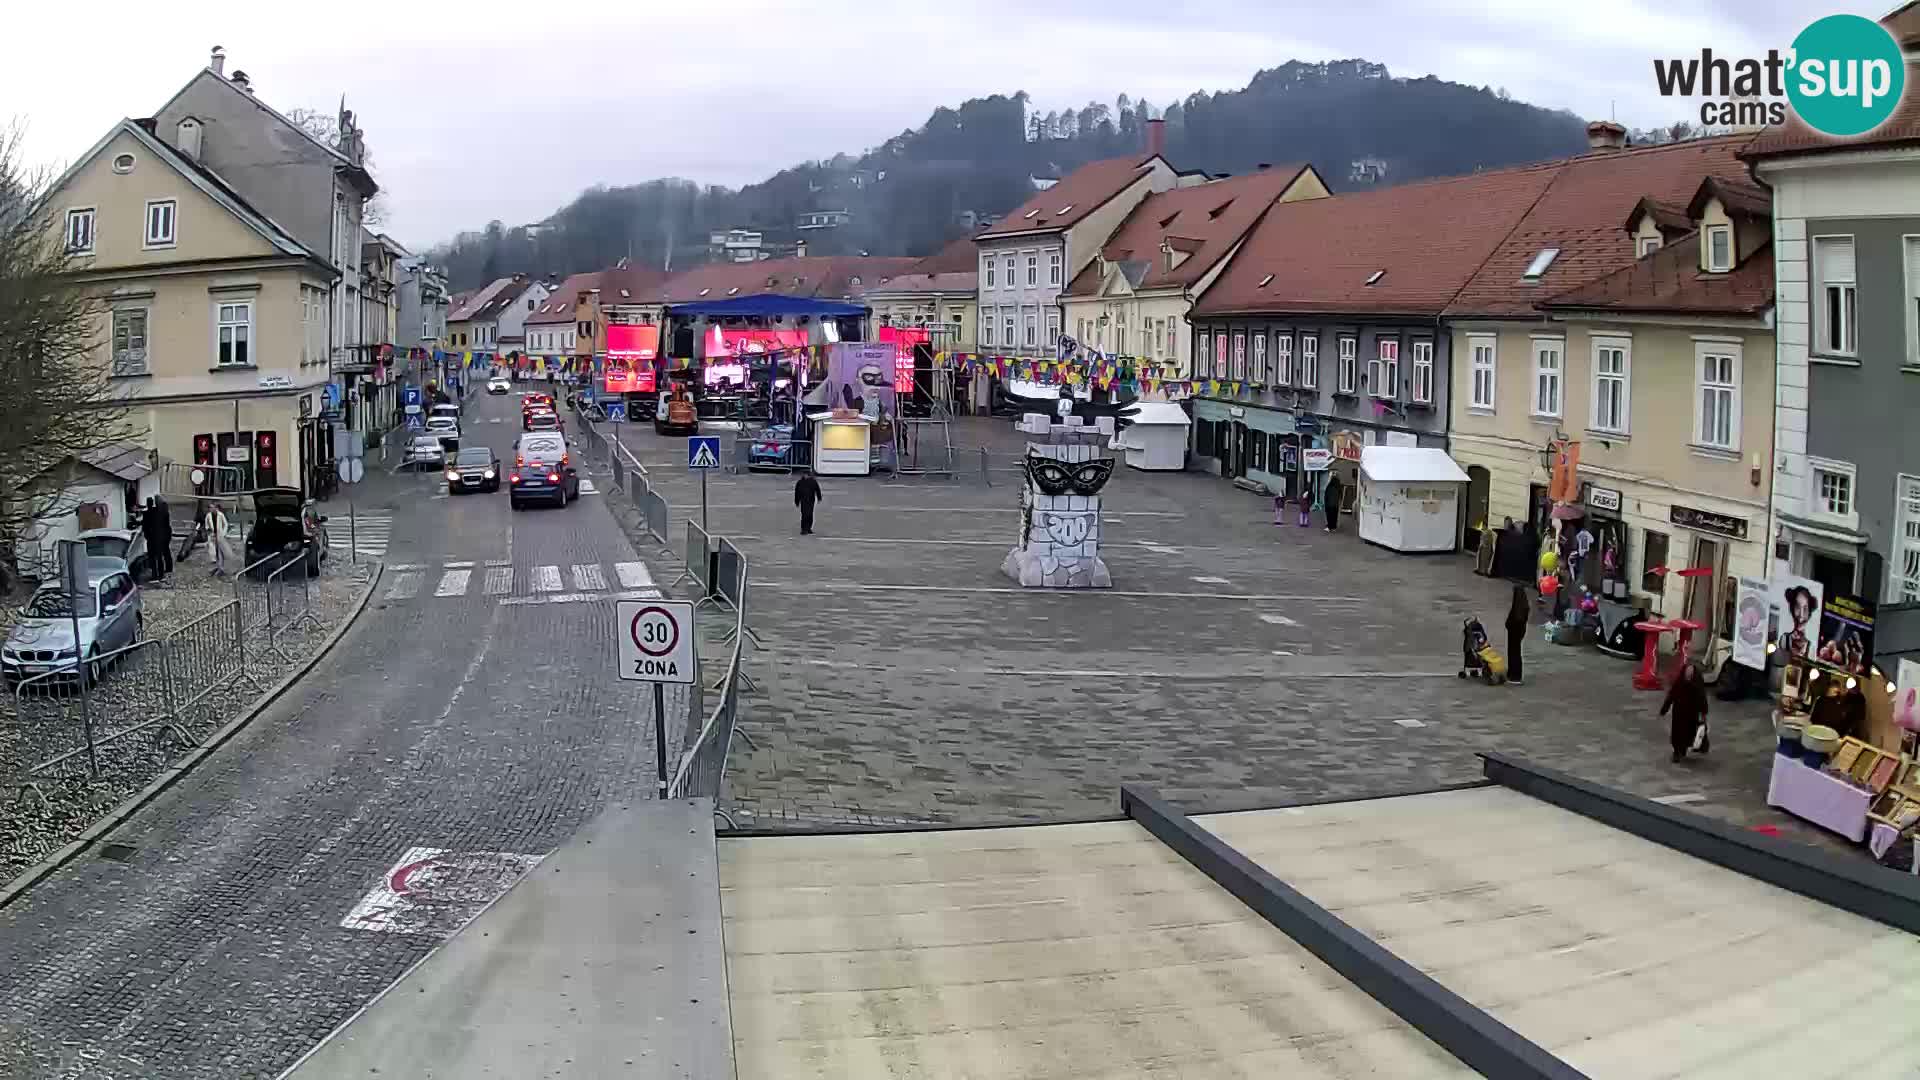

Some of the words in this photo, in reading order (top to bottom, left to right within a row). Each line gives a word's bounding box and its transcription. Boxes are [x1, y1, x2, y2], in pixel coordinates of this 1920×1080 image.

[408, 391, 416, 402] P
[643, 622, 668, 643] 30
[634, 659, 678, 676] ZONA
